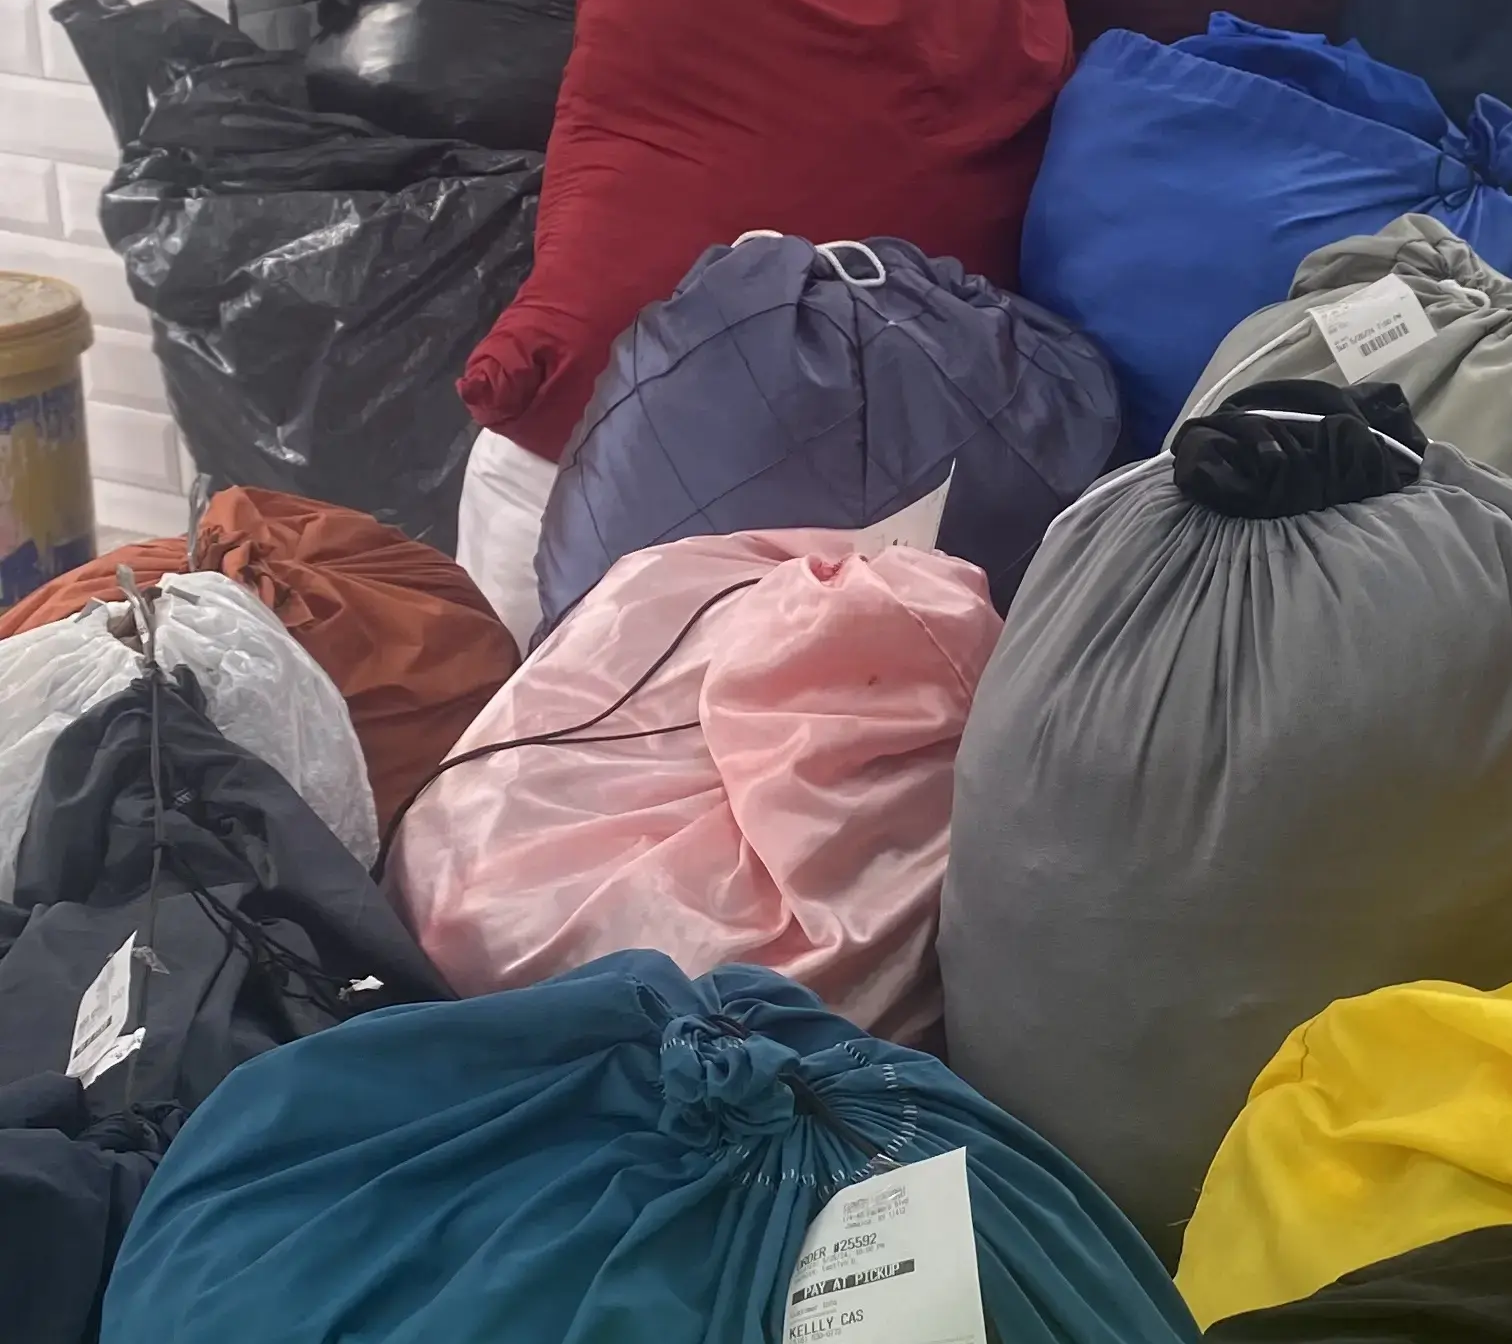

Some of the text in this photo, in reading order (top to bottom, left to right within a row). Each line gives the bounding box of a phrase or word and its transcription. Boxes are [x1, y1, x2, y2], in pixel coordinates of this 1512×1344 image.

[833, 1232, 878, 1253] #25592
[803, 1280, 827, 1299] PAY
[832, 1276, 848, 1291] AT
[854, 1262, 900, 1286] PICKUP
[788, 1316, 834, 1340] KELLLY
[840, 1309, 865, 1325] CAS
